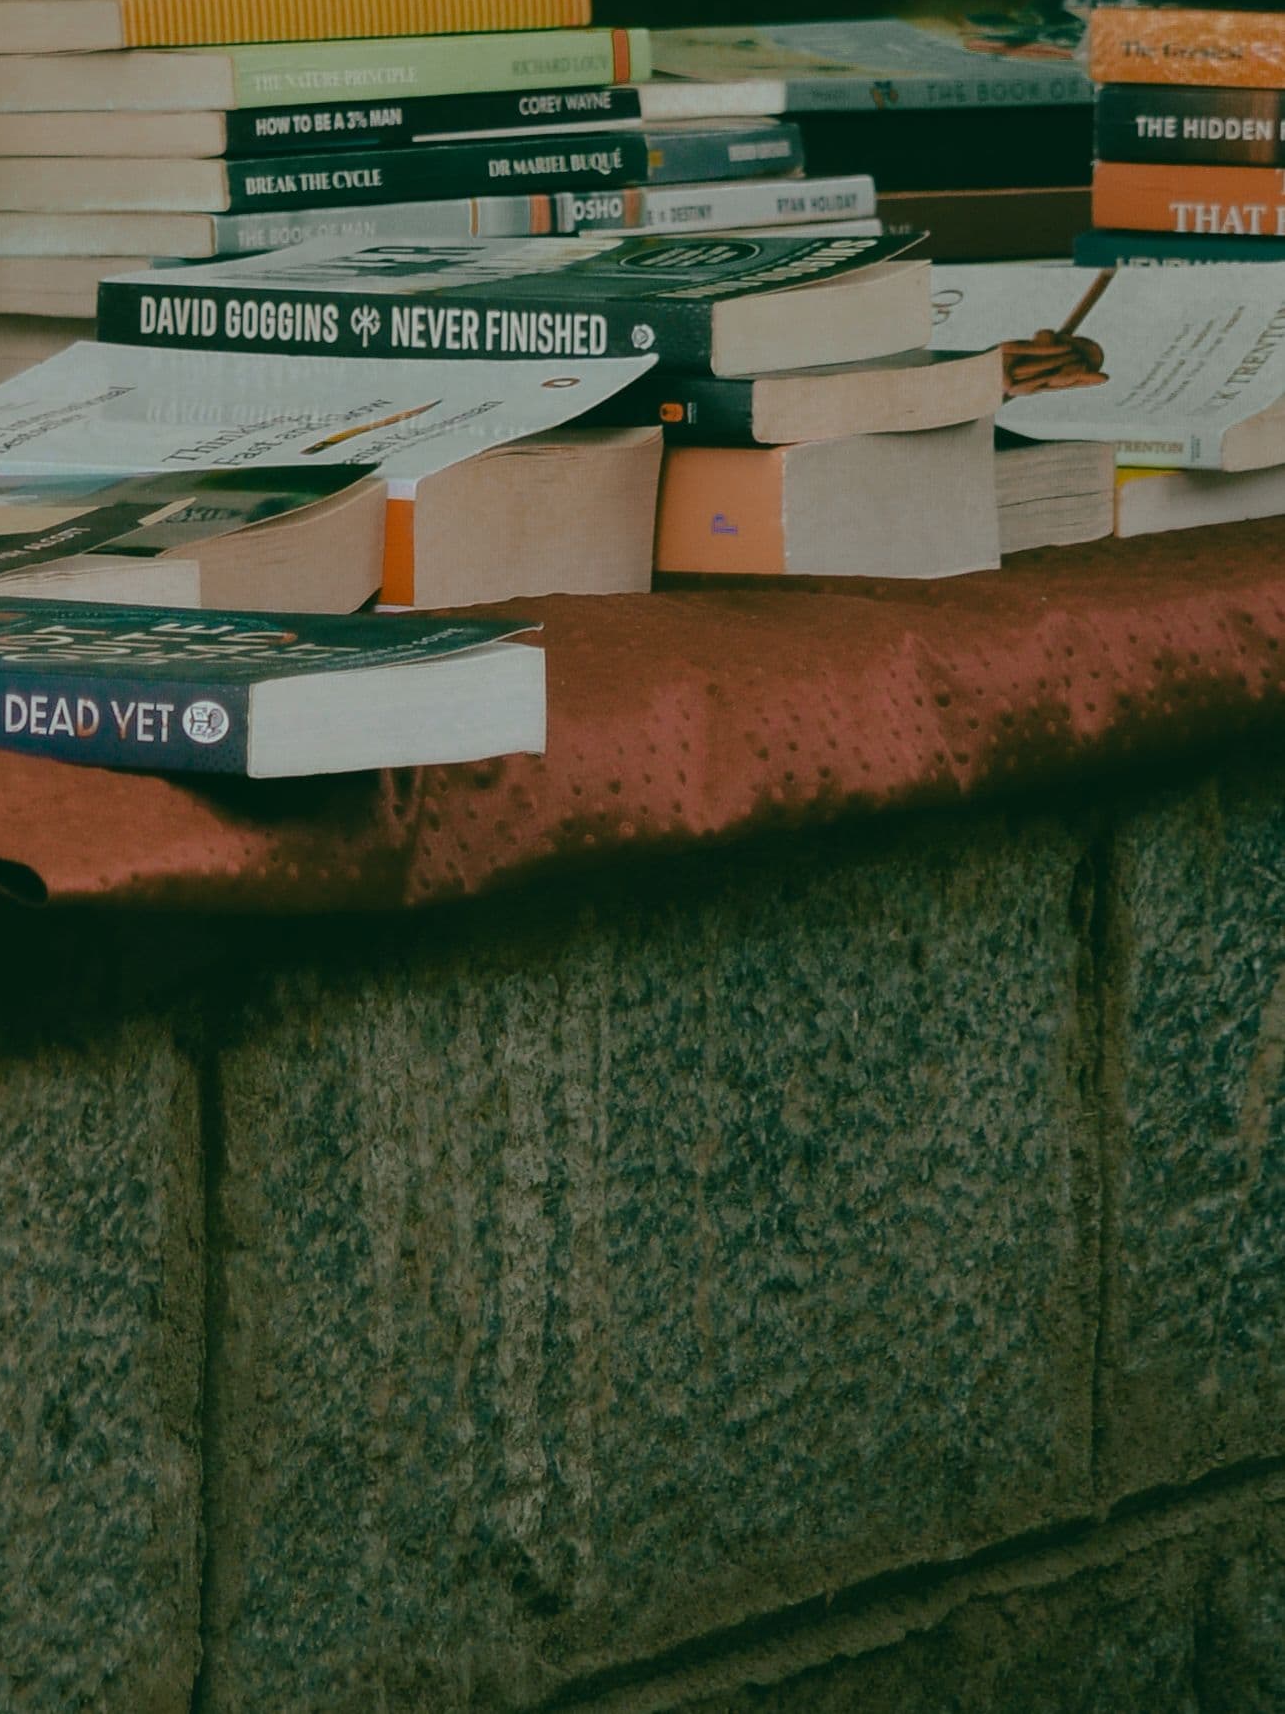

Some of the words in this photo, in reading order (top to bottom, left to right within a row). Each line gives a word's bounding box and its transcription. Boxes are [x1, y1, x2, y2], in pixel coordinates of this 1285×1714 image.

[518, 96, 562, 116] COREY
[565, 91, 613, 111] WAYNE
[255, 117, 291, 137] HOW
[292, 115, 313, 134] TO
[314, 113, 332, 132] BE
[334, 111, 346, 130] A
[346, 110, 368, 129] 3%
[369, 107, 403, 127] MAN
[1135, 115, 1178, 139] THE
[1183, 116, 1275, 142] HIDDEN
[488, 158, 511, 178] DR
[514, 153, 568, 176] MARIEL
[570, 146, 625, 176] BUQUÉ
[245, 174, 297, 196] BREAK
[298, 172, 331, 193] THE
[331, 168, 384, 191] CYCLE
[572, 198, 624, 224] OSHO
[669, 204, 713, 223] DESTINY
[1169, 203, 1266, 235] THAT
[238, 227, 266, 249] THE
[140, 296, 217, 336] DAVID
[224, 299, 340, 343] GOGGINS
[391, 306, 479, 350] NEVER
[485, 310, 608, 356] FINISHED
[1115, 439, 1185, 454] TRENTON
[4, 694, 101, 738] DEAD
[110, 700, 175, 743] YET
